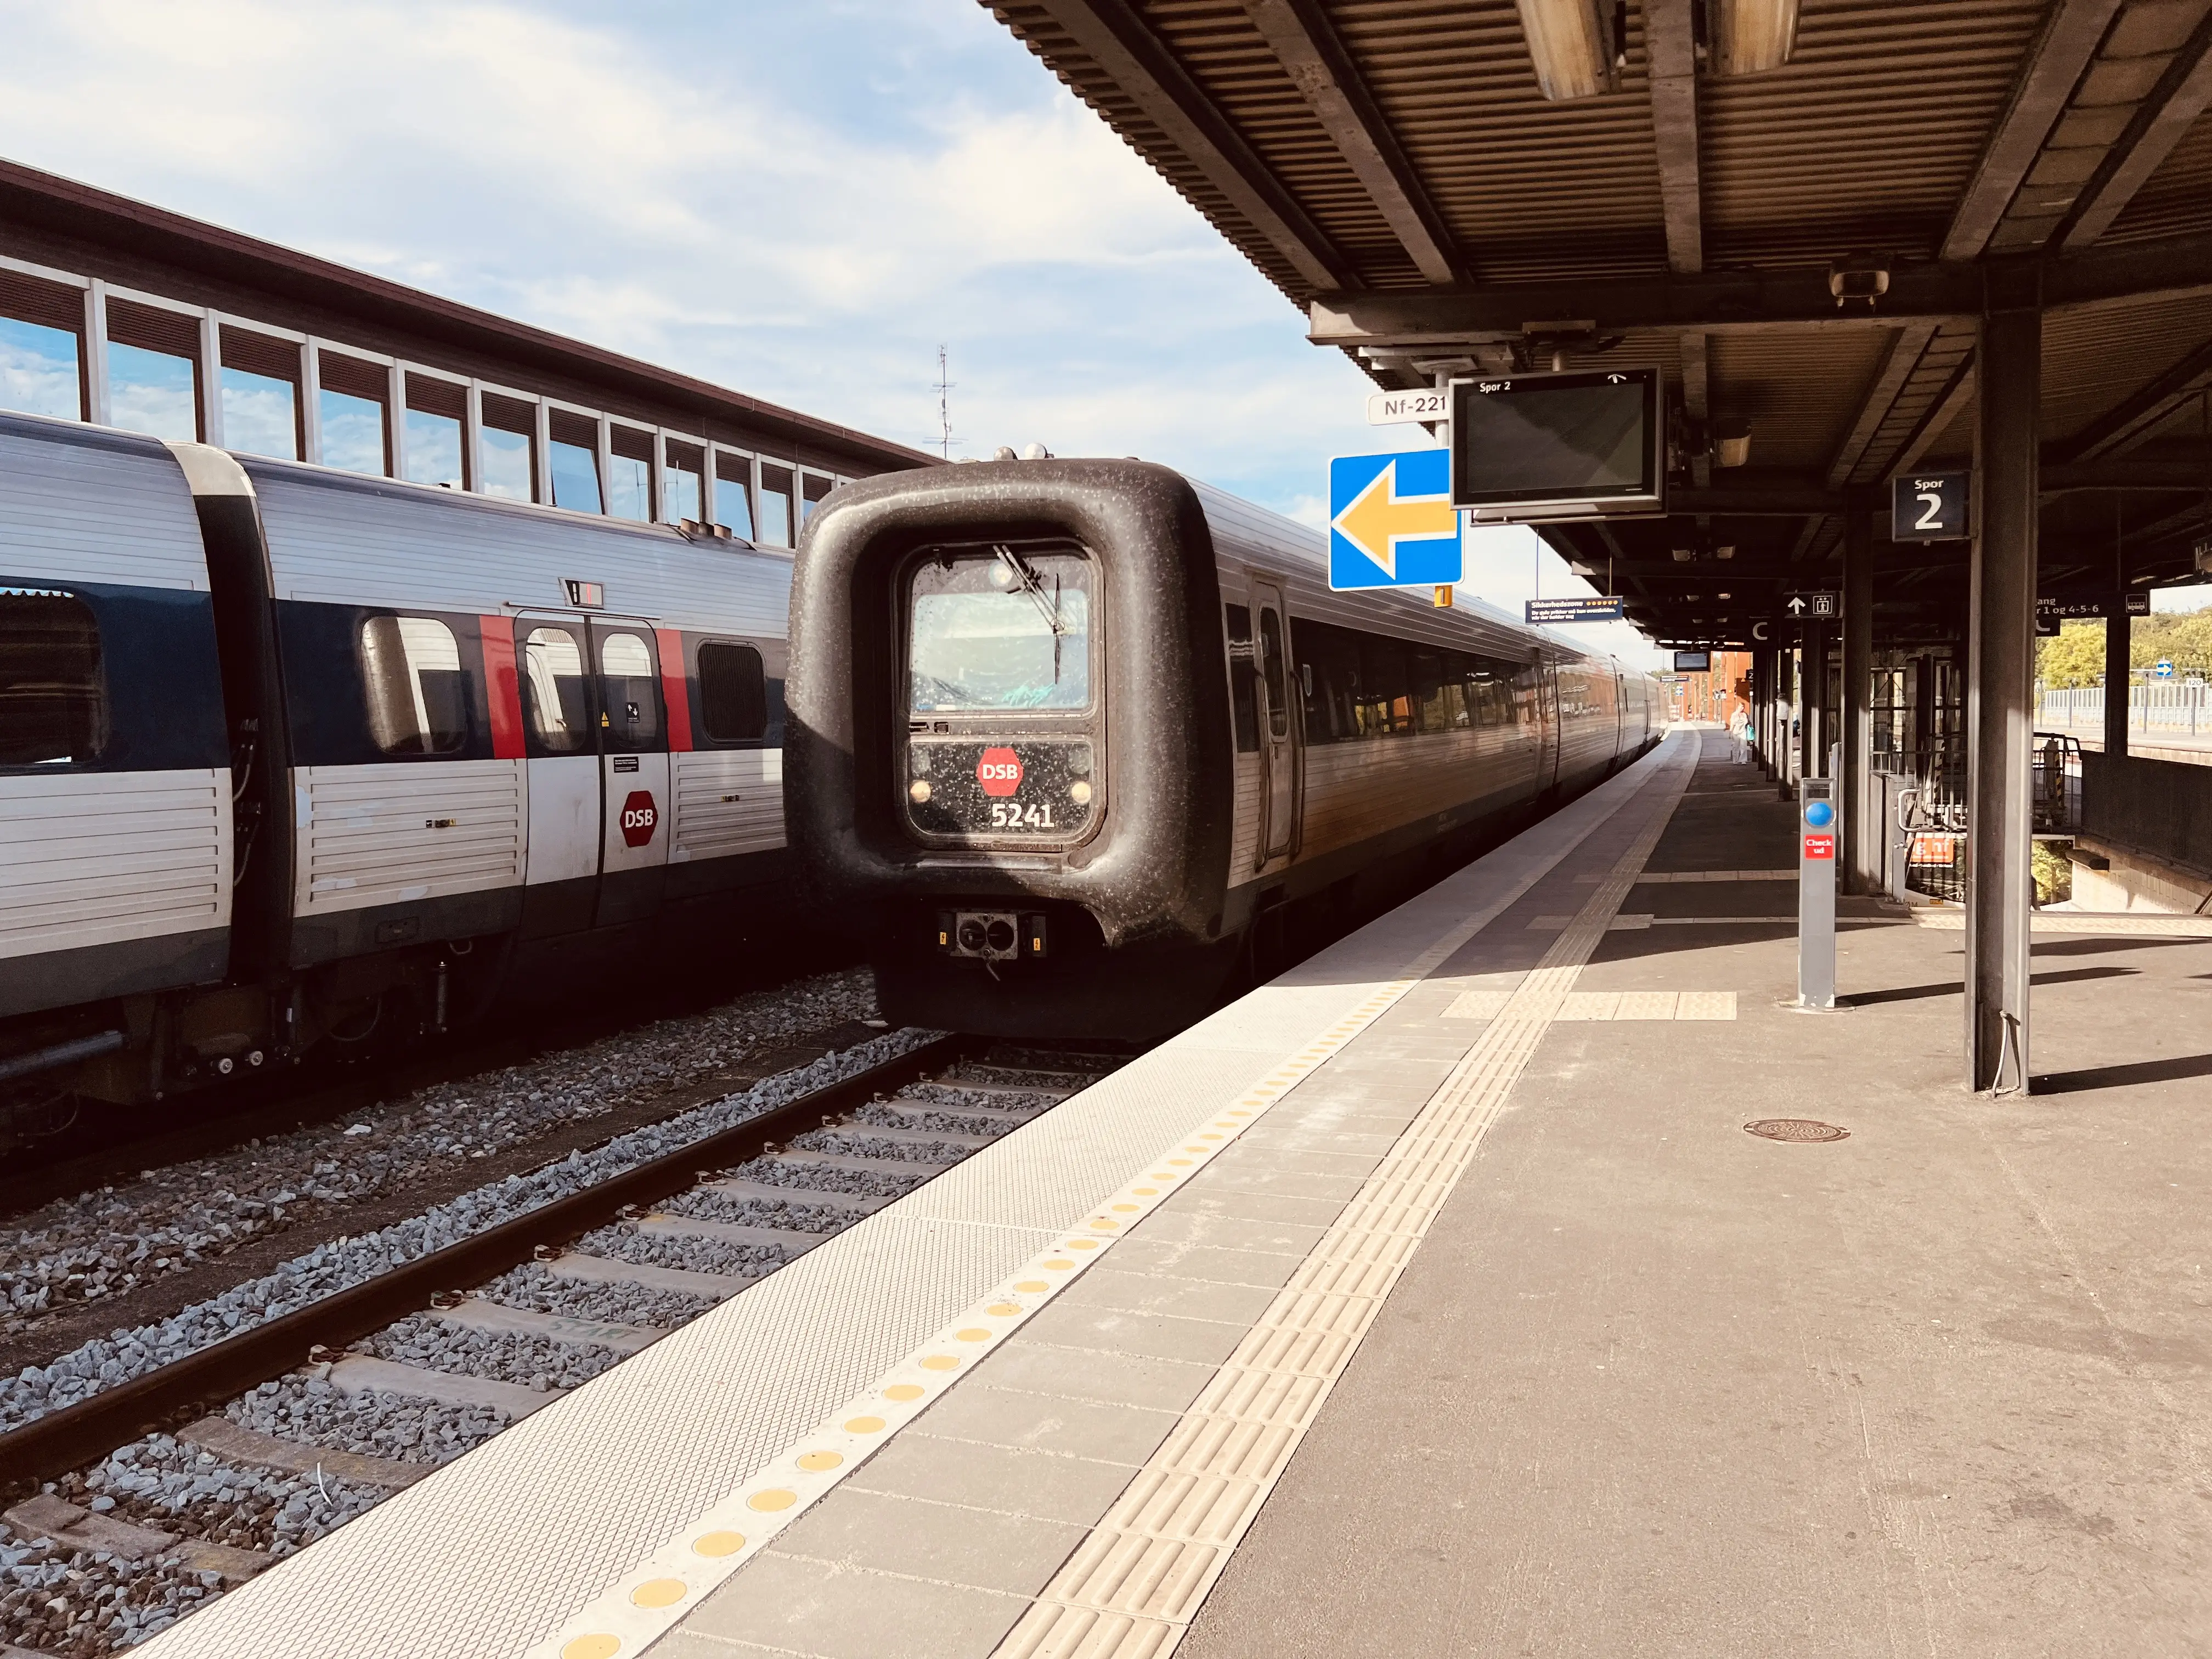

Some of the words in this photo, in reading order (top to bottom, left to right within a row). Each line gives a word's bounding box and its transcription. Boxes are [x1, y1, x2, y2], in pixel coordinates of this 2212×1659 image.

[1480, 382, 1501, 393] Spor
[1504, 381, 1511, 390] 2
[1385, 396, 1445, 415] Nf-221
[1914, 479, 1944, 491] Spor
[1915, 494, 1943, 529] 2
[2069, 605, 2099, 613] 4-5-6
[1752, 622, 1768, 640] C
[983, 764, 1018, 780] DSB
[625, 809, 653, 828] DSB
[991, 803, 1055, 827] 5241
